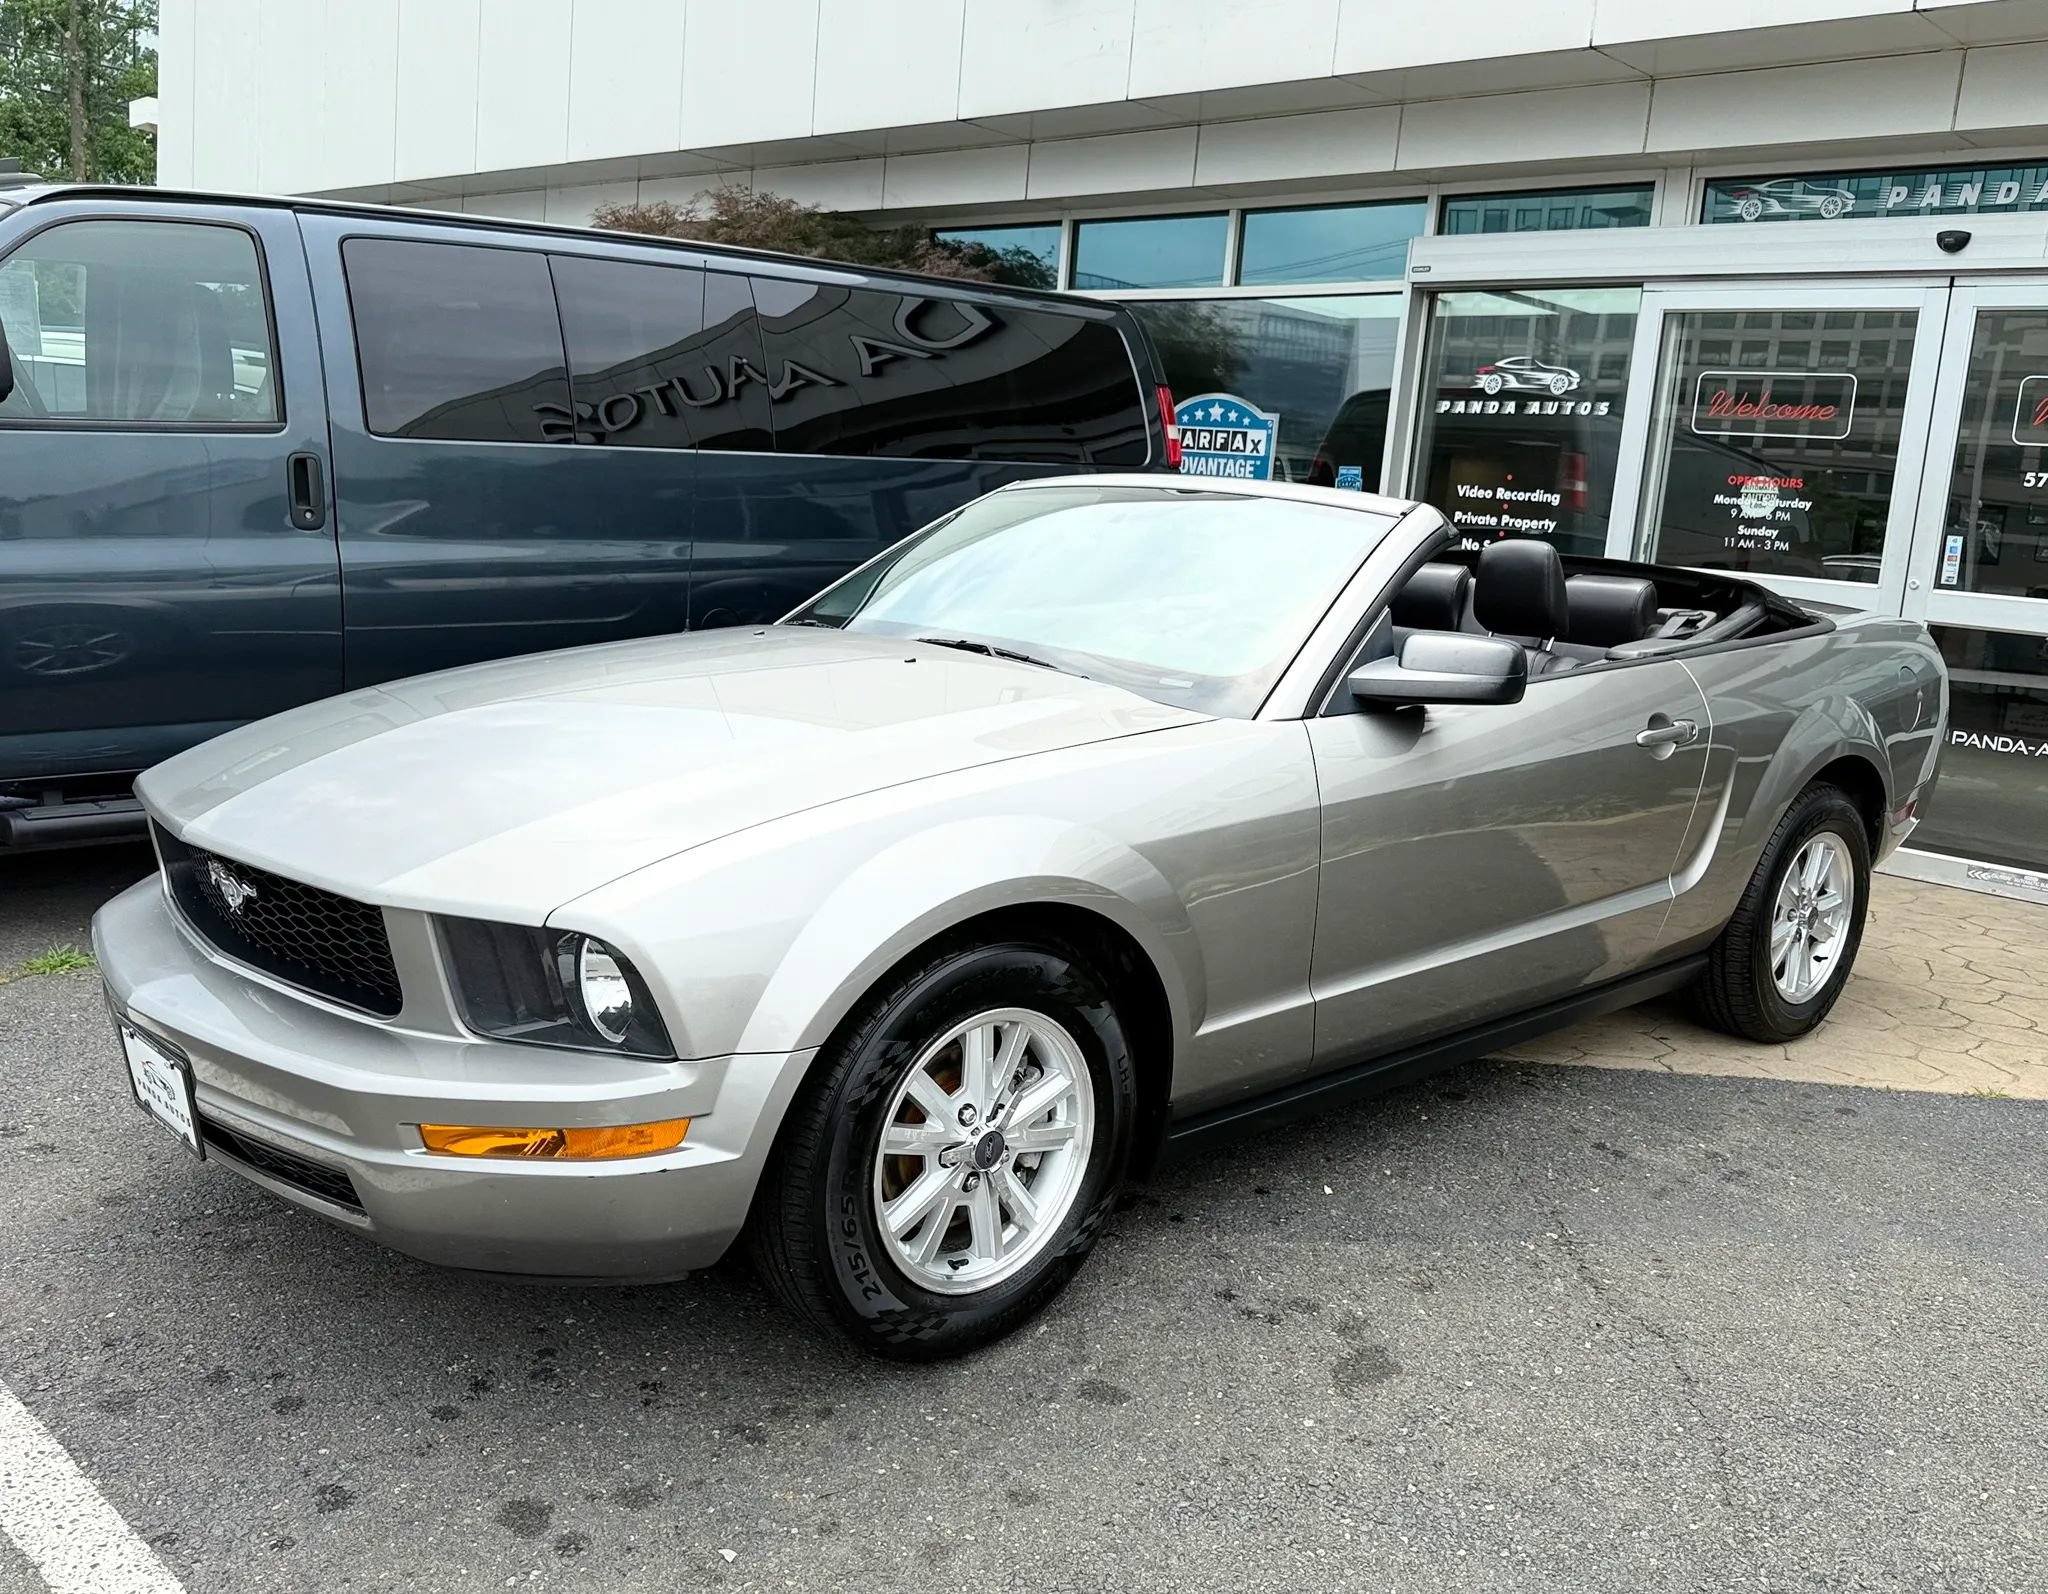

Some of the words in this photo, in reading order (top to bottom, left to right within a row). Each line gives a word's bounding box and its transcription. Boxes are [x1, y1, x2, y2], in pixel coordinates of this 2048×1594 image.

[1434, 400, 1517, 415] PANDA
[1522, 401, 1611, 416] AUTOS
[1708, 390, 1838, 421] Welcome
[1180, 430, 1263, 454] ARFAX
[1180, 455, 1256, 479] DVANTAGE
[1727, 475, 1761, 486] OPEN
[1763, 477, 1805, 489] HOURS
[1457, 484, 1493, 500] Video
[1495, 487, 1561, 506] Recording
[1453, 511, 1498, 527] Private
[1500, 515, 1557, 533] Property
[1730, 508, 1738, 519] 9
[1765, 511, 1773, 521] 6
[1775, 511, 1791, 522] PM
[1737, 525, 1779, 540] Sunday
[1461, 539, 1480, 551] No
[1724, 537, 1735, 548] 11
[1737, 539, 1755, 549] AM
[1764, 540, 1772, 551] 3
[1773, 541, 1789, 552] PM
